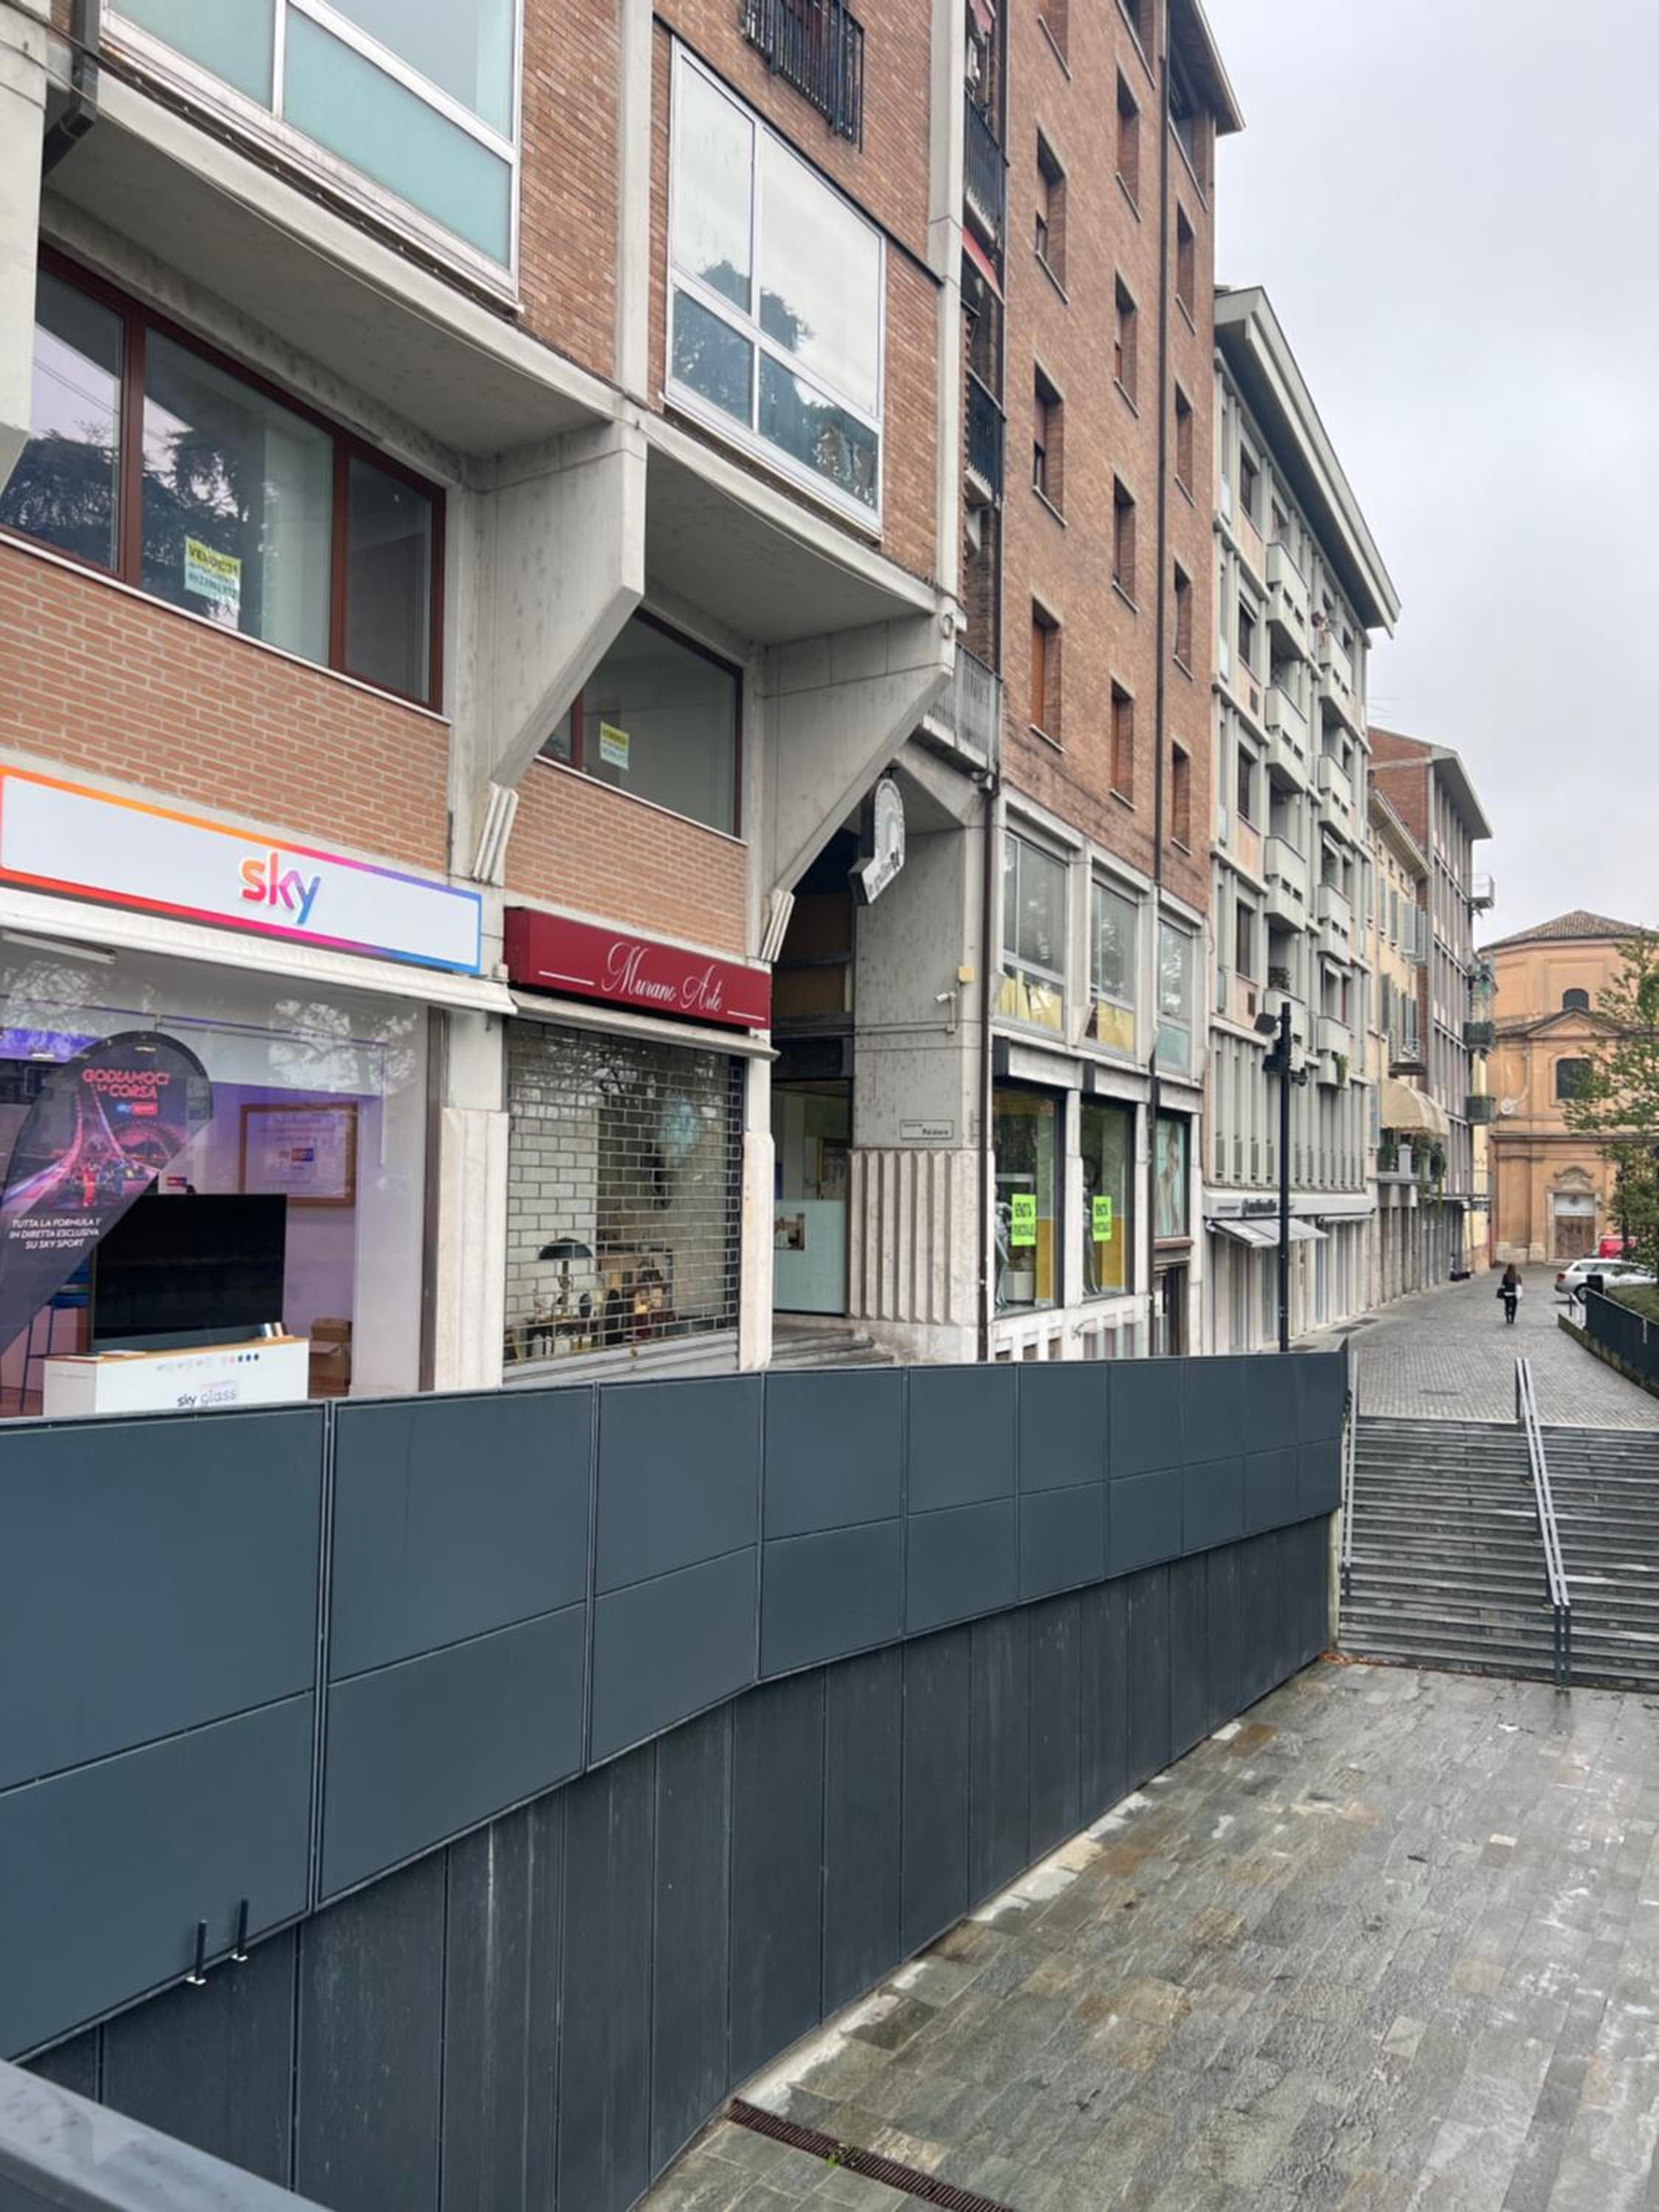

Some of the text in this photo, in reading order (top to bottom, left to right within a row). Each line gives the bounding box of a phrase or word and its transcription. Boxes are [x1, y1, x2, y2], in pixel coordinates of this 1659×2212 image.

[242, 852, 321, 925] sky
[601, 942, 722, 1012] Murano Arte
[82, 1068, 170, 1085] GODIAMOCI
[108, 1085, 158, 1098] CORSA
[13, 1219, 38, 1228] TUTTA
[40, 1219, 52, 1227] LA
[52, 1217, 94, 1227] FORMULA
[9, 1228, 100, 1239] IN DIRETTA ESCLUSIVA
[25, 1238, 84, 1250] SU SKY SPORT
[177, 1389, 237, 1408] sky glass
